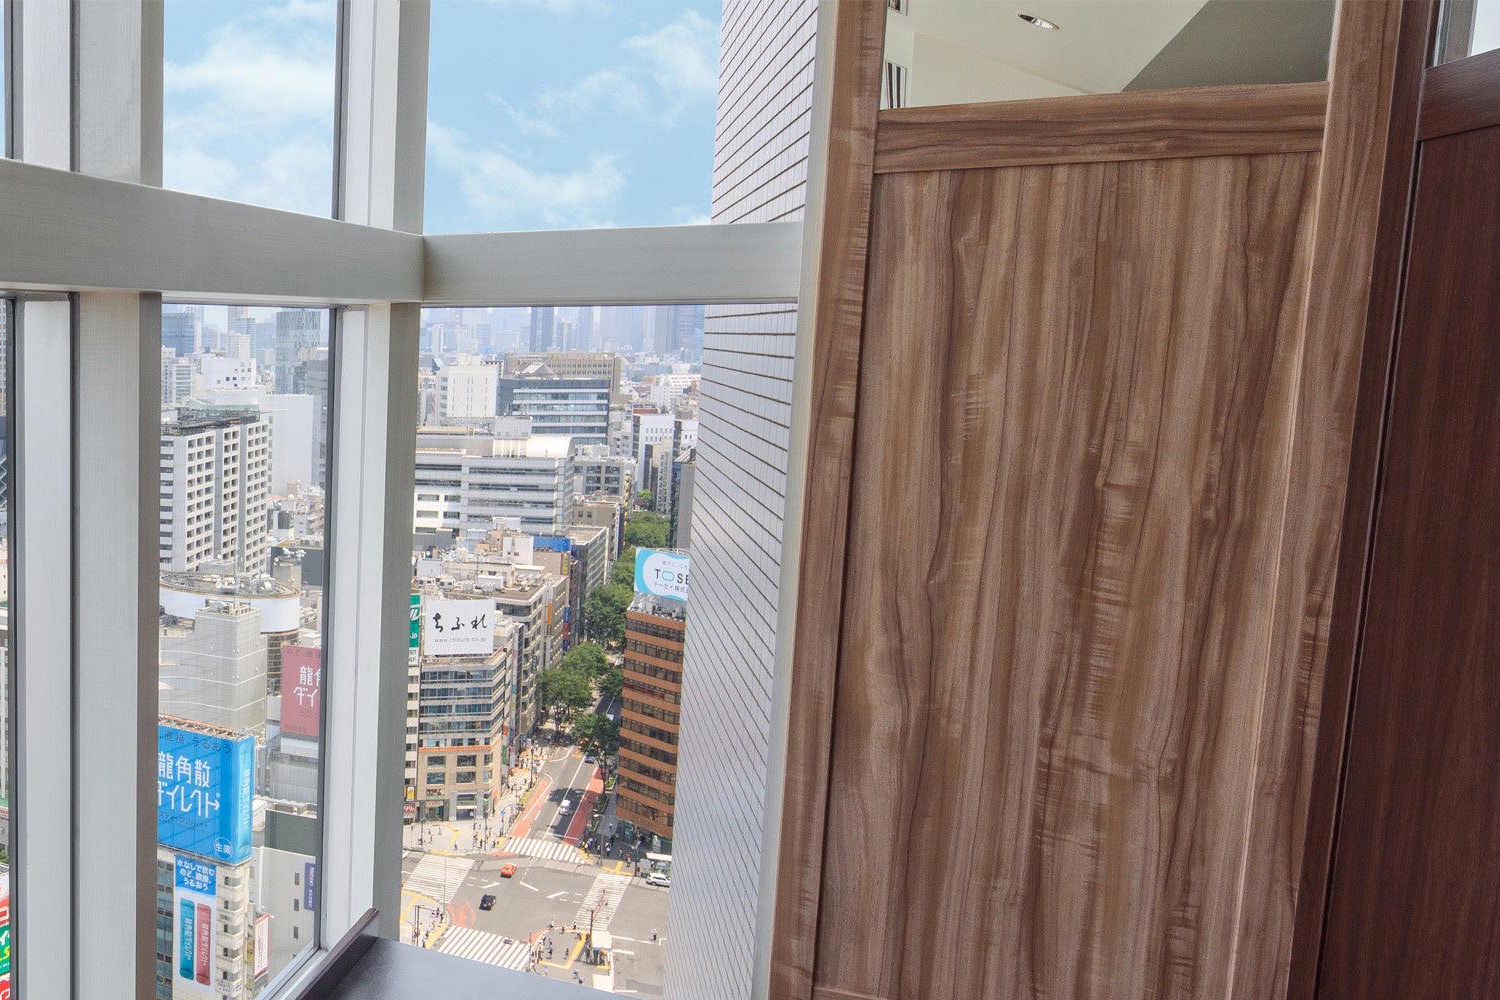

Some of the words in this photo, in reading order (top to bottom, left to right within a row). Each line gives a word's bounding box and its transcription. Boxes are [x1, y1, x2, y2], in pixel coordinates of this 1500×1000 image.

[433, 612, 487, 632] ちふれ
[158, 751, 211, 788] 龍角散
